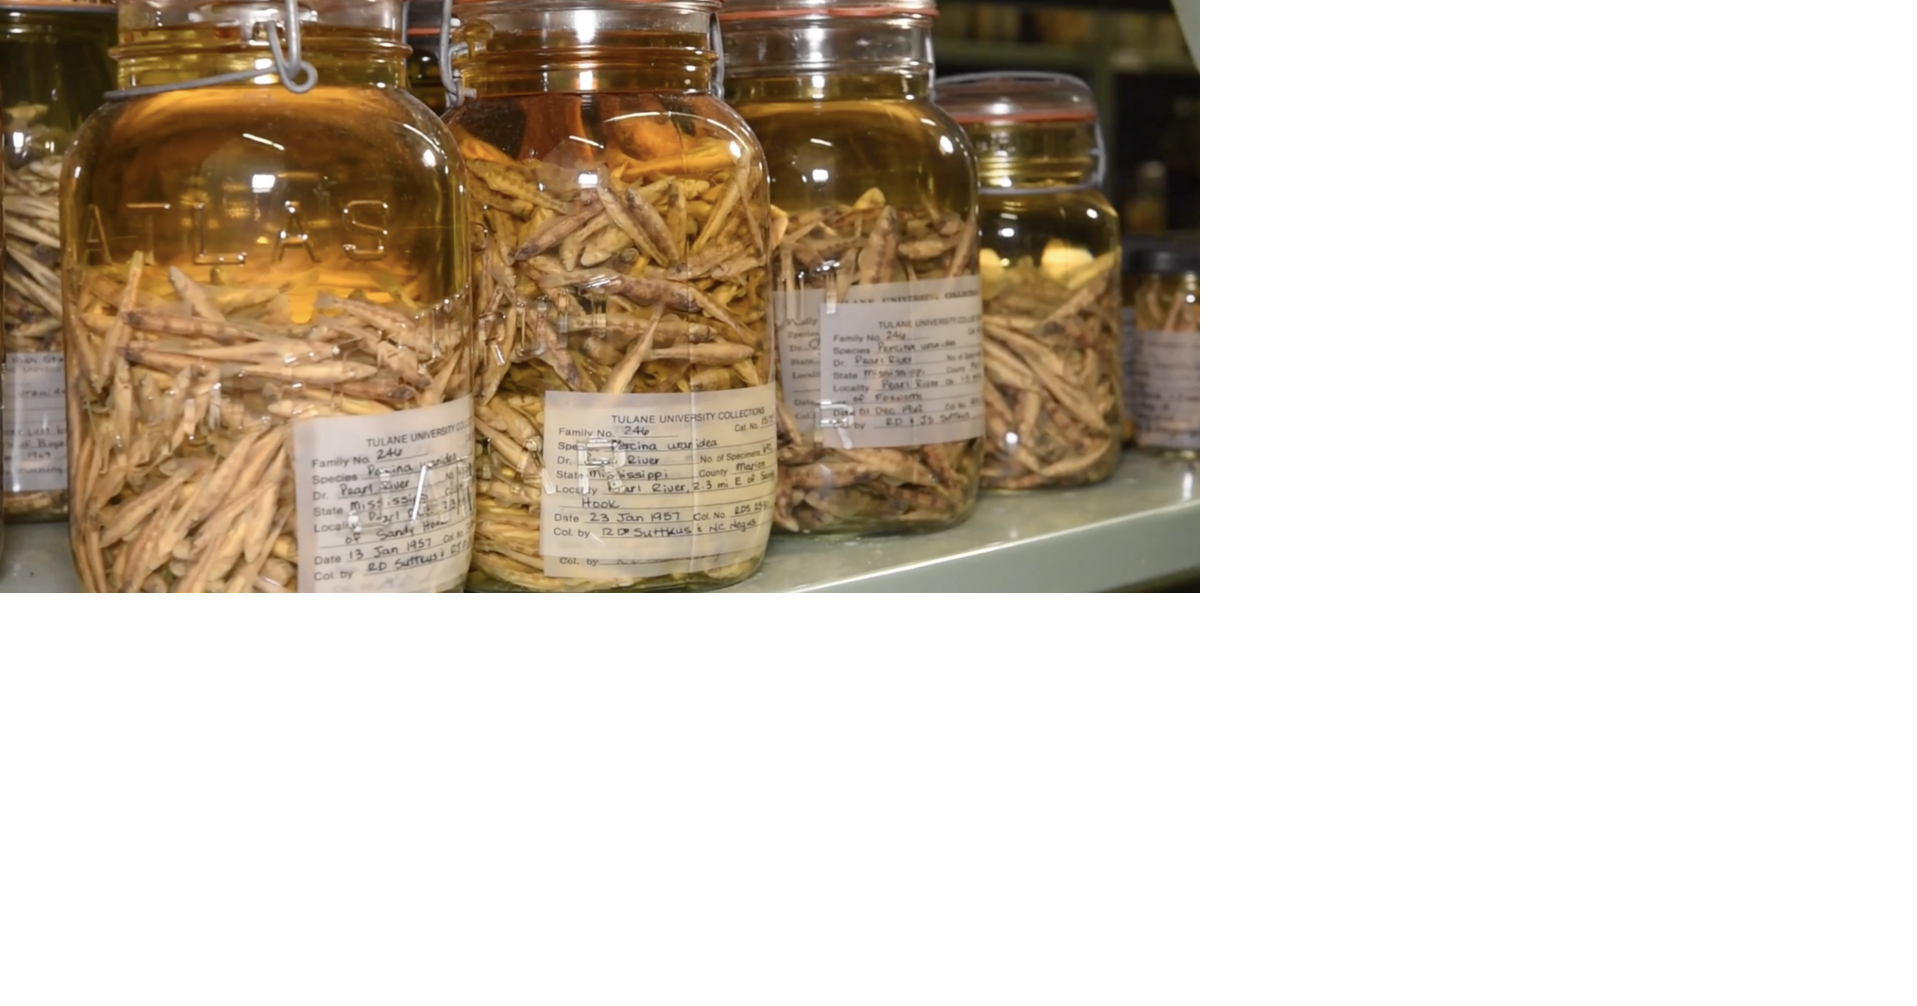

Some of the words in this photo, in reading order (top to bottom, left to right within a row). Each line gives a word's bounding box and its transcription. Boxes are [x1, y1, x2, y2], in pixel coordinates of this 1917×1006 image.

[80, 199, 388, 266] ATLAS
[878, 320, 912, 329] TULANE
[915, 317, 957, 328] UNIVERSITY
[833, 334, 863, 343] Family
[833, 347, 871, 355] Species
[793, 371, 820, 379] Locali
[833, 372, 858, 380] State
[833, 384, 870, 393] Locality
[611, 414, 656, 424] TULANE
[659, 412, 716, 424] UNIVERSITY
[718, 406, 766, 421] COLLECTIONS
[366, 434, 409, 449] TULANE
[411, 424, 456, 443] UNIVERSITY
[558, 427, 594, 437] Family
[597, 429, 615, 438] No.
[623, 426, 650, 436] 246
[312, 457, 350, 469] Family
[376, 448, 404, 460] 246
[557, 456, 572, 465] Dr.
[627, 456, 660, 465] River
[700, 455, 715, 464] No.
[717, 452, 725, 462] of
[726, 449, 761, 463] Specimens
[312, 474, 359, 486] Species
[589, 469, 668, 481] Miissippi
[699, 468, 728, 480] County
[608, 481, 641, 493] Parl
[693, 480, 712, 491] 2.3
[735, 476, 742, 486] E
[313, 490, 329, 501] Dr.
[339, 482, 373, 496] Pearl
[582, 497, 620, 509] Hook
[313, 506, 344, 517] State
[554, 513, 580, 523] Date
[590, 512, 609, 523] 23
[617, 512, 644, 523] Jan
[651, 511, 681, 521] 1957
[693, 511, 712, 521] Col.
[713, 509, 727, 519] No.
[345, 533, 361, 544] of
[376, 526, 415, 542] Sandy
[553, 527, 574, 537] Col.
[578, 528, 591, 540] by
[314, 555, 342, 566] Date
[349, 548, 364, 560] 13
[373, 545, 399, 559] Jan
[407, 536, 432, 552] 1957
[559, 556, 580, 566] Col.
[586, 556, 600, 568] by
[340, 568, 354, 580] by
[368, 560, 388, 573] RD
